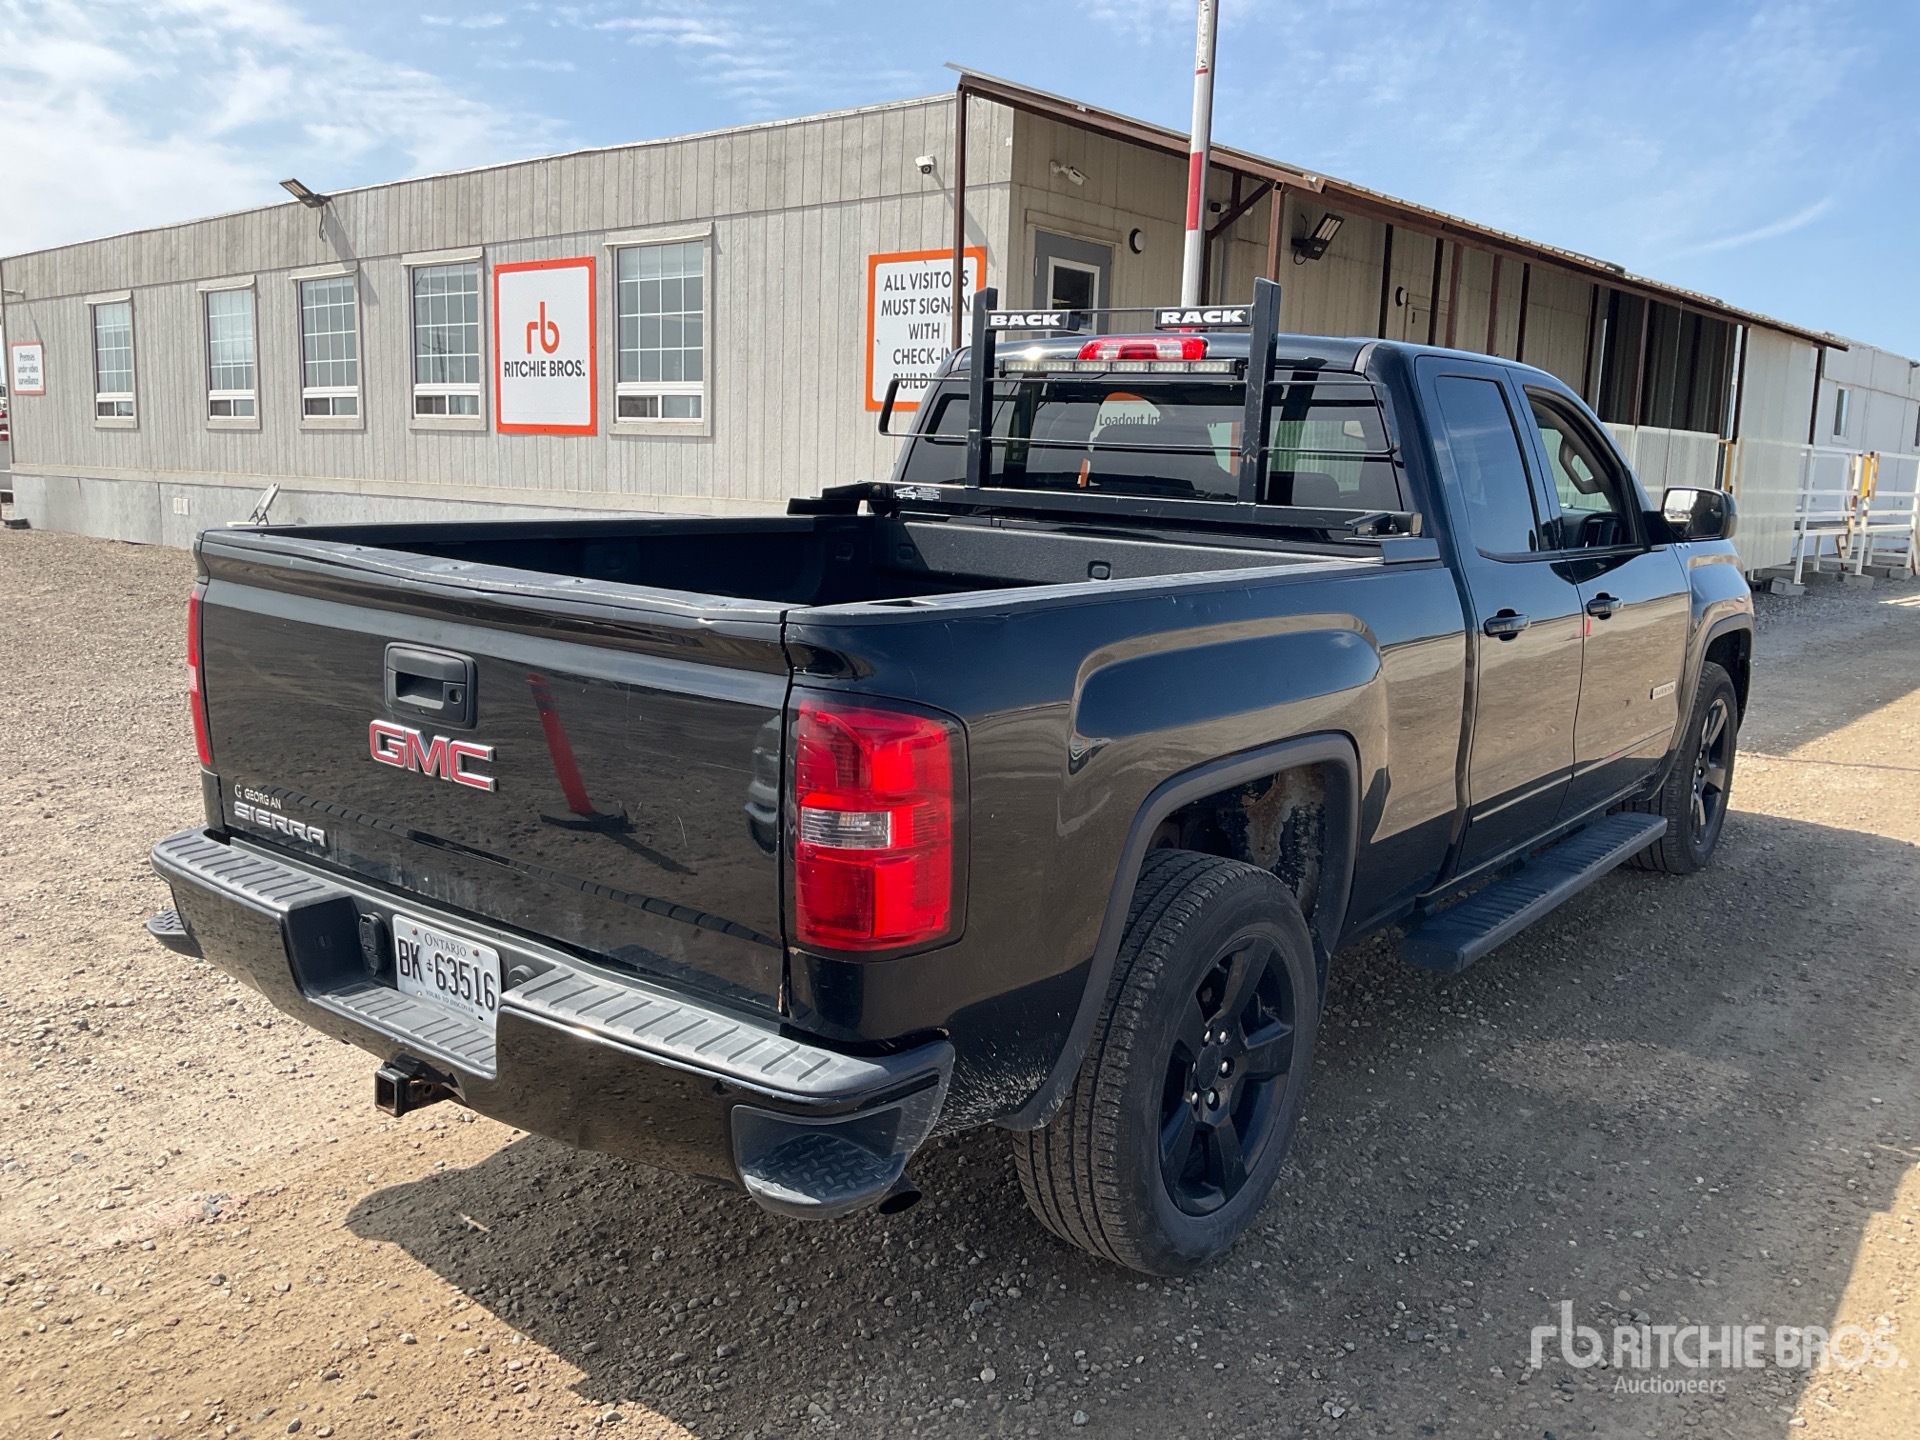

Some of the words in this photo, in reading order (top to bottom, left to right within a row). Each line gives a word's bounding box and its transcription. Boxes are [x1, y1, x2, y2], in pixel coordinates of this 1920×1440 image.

[884, 274, 906, 291] ALL
[909, 270, 969, 290] VISITOS
[881, 298, 916, 316] MUST
[919, 295, 970, 314] SIGN-N
[990, 314, 1061, 326] BACK
[1160, 310, 1244, 324] RACK
[908, 322, 940, 340] WITH
[504, 361, 547, 377] RITCHIE
[549, 359, 586, 377] BROS.
[1100, 413, 1145, 426] Loadout
[369, 719, 498, 792] GMC
[234, 801, 327, 847] SIERRA
[424, 932, 467, 957] ONTARIO
[398, 937, 422, 982] BK
[434, 951, 495, 1011] 63516
